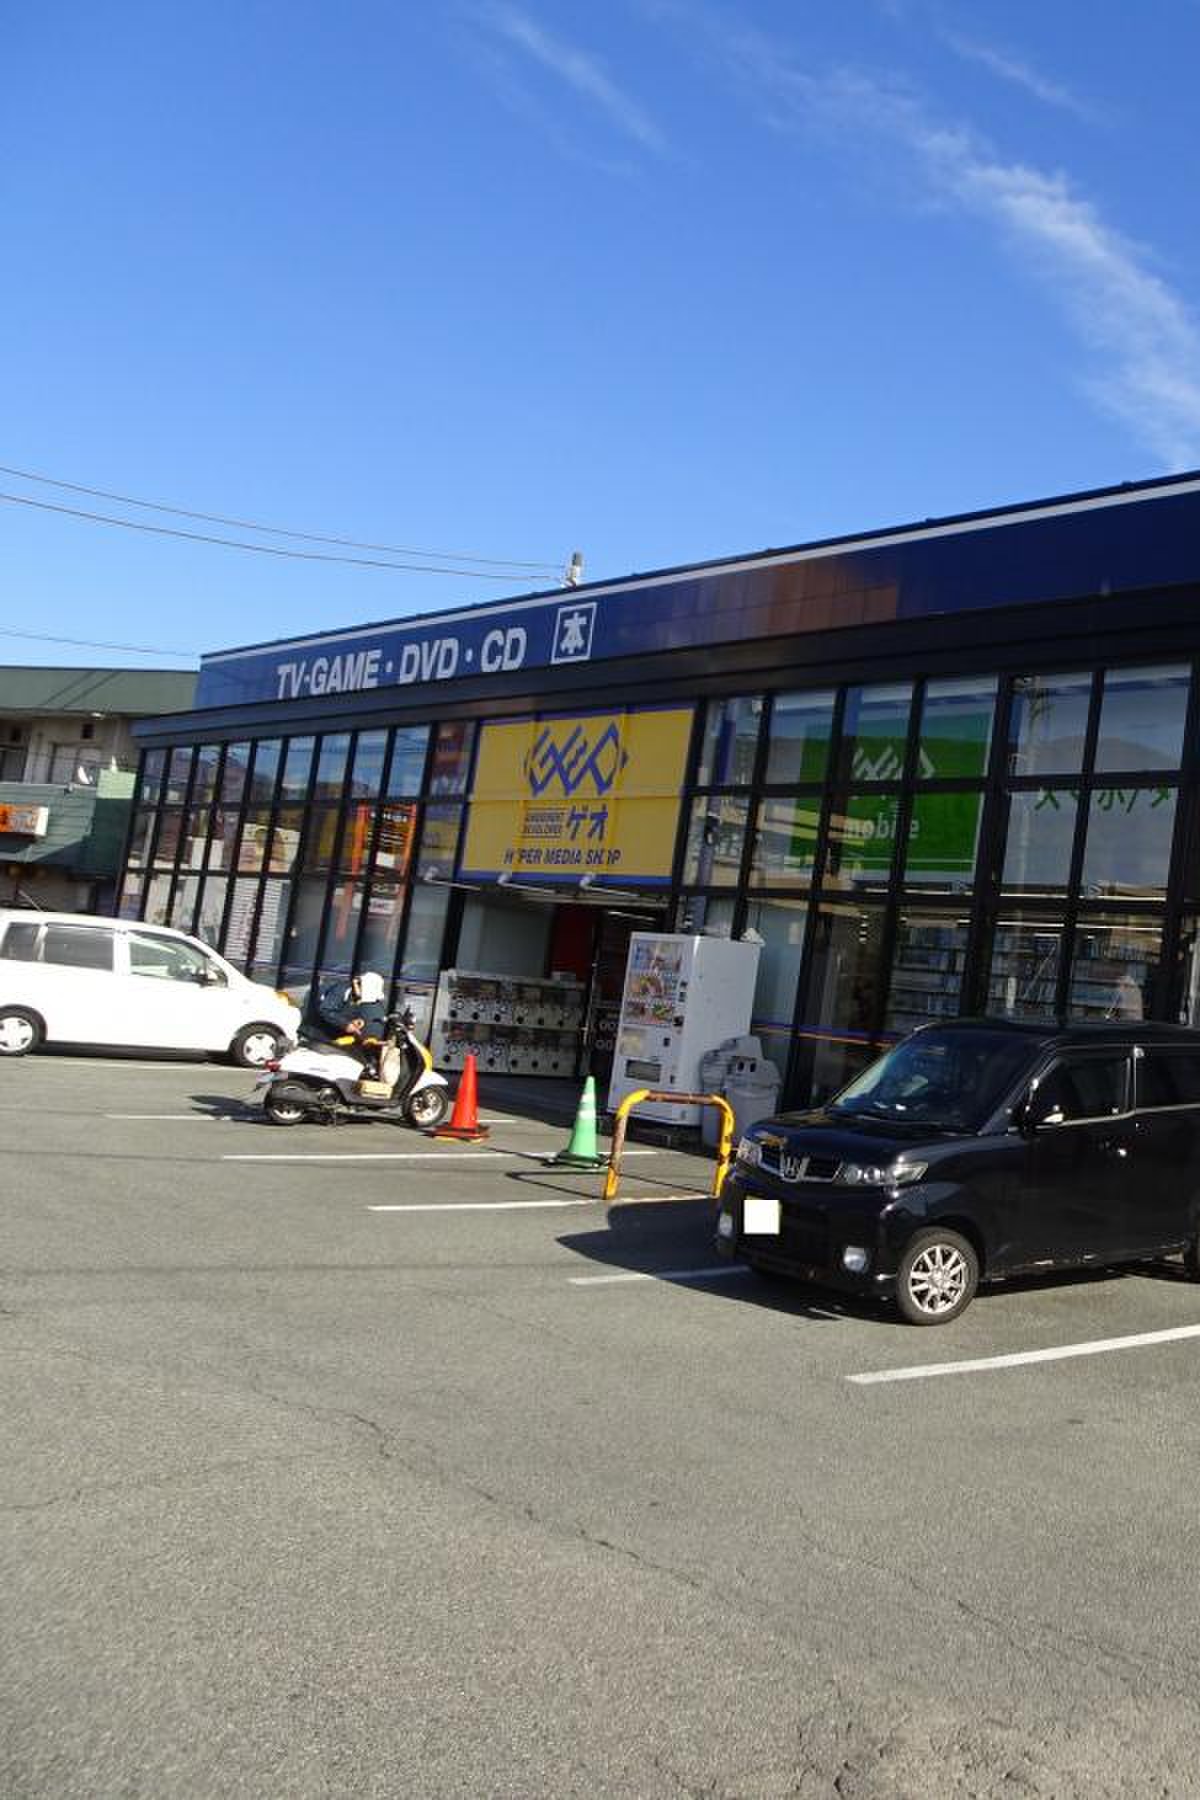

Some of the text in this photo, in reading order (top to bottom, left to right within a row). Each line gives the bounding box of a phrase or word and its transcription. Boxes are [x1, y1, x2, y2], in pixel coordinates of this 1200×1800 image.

[560, 611, 587, 655] 本
[398, 637, 459, 685] DVD
[480, 627, 528, 673] CD
[566, 804, 608, 841] ゲオ
[543, 848, 582, 865] MEDIA
